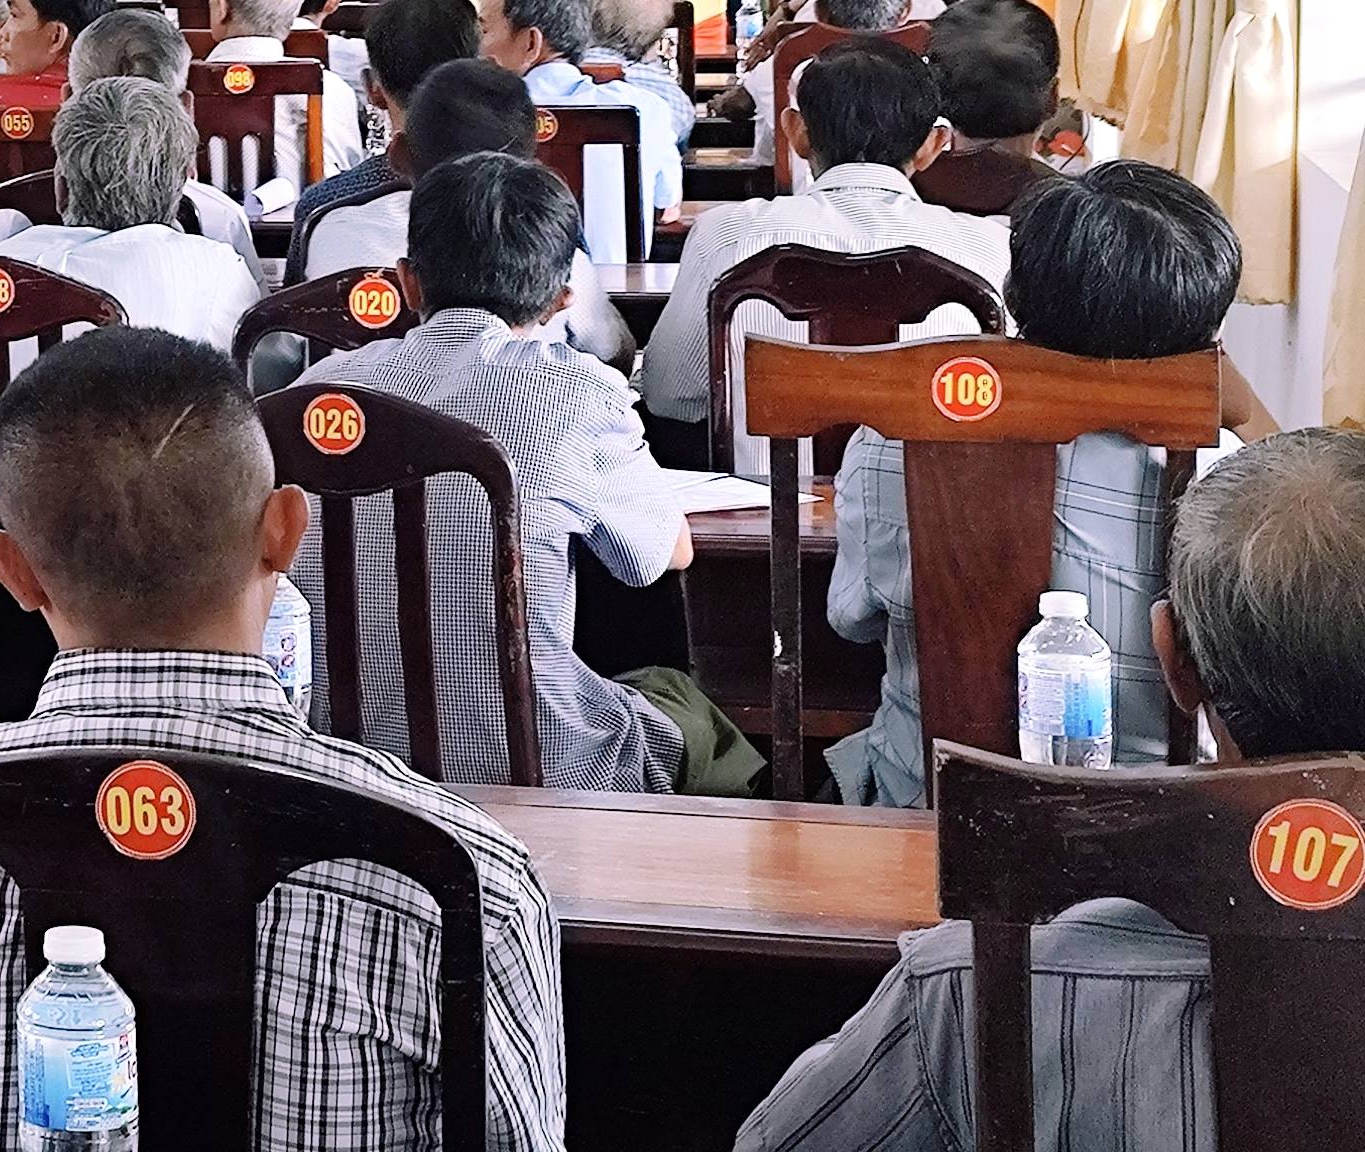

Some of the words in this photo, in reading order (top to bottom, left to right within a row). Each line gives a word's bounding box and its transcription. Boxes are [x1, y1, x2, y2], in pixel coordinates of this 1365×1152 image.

[4, 113, 31, 133] 055
[352, 289, 396, 317] 020
[938, 370, 995, 409] 108
[311, 408, 359, 441] 026
[105, 784, 188, 835] 063
[1266, 829, 1360, 885] 107
